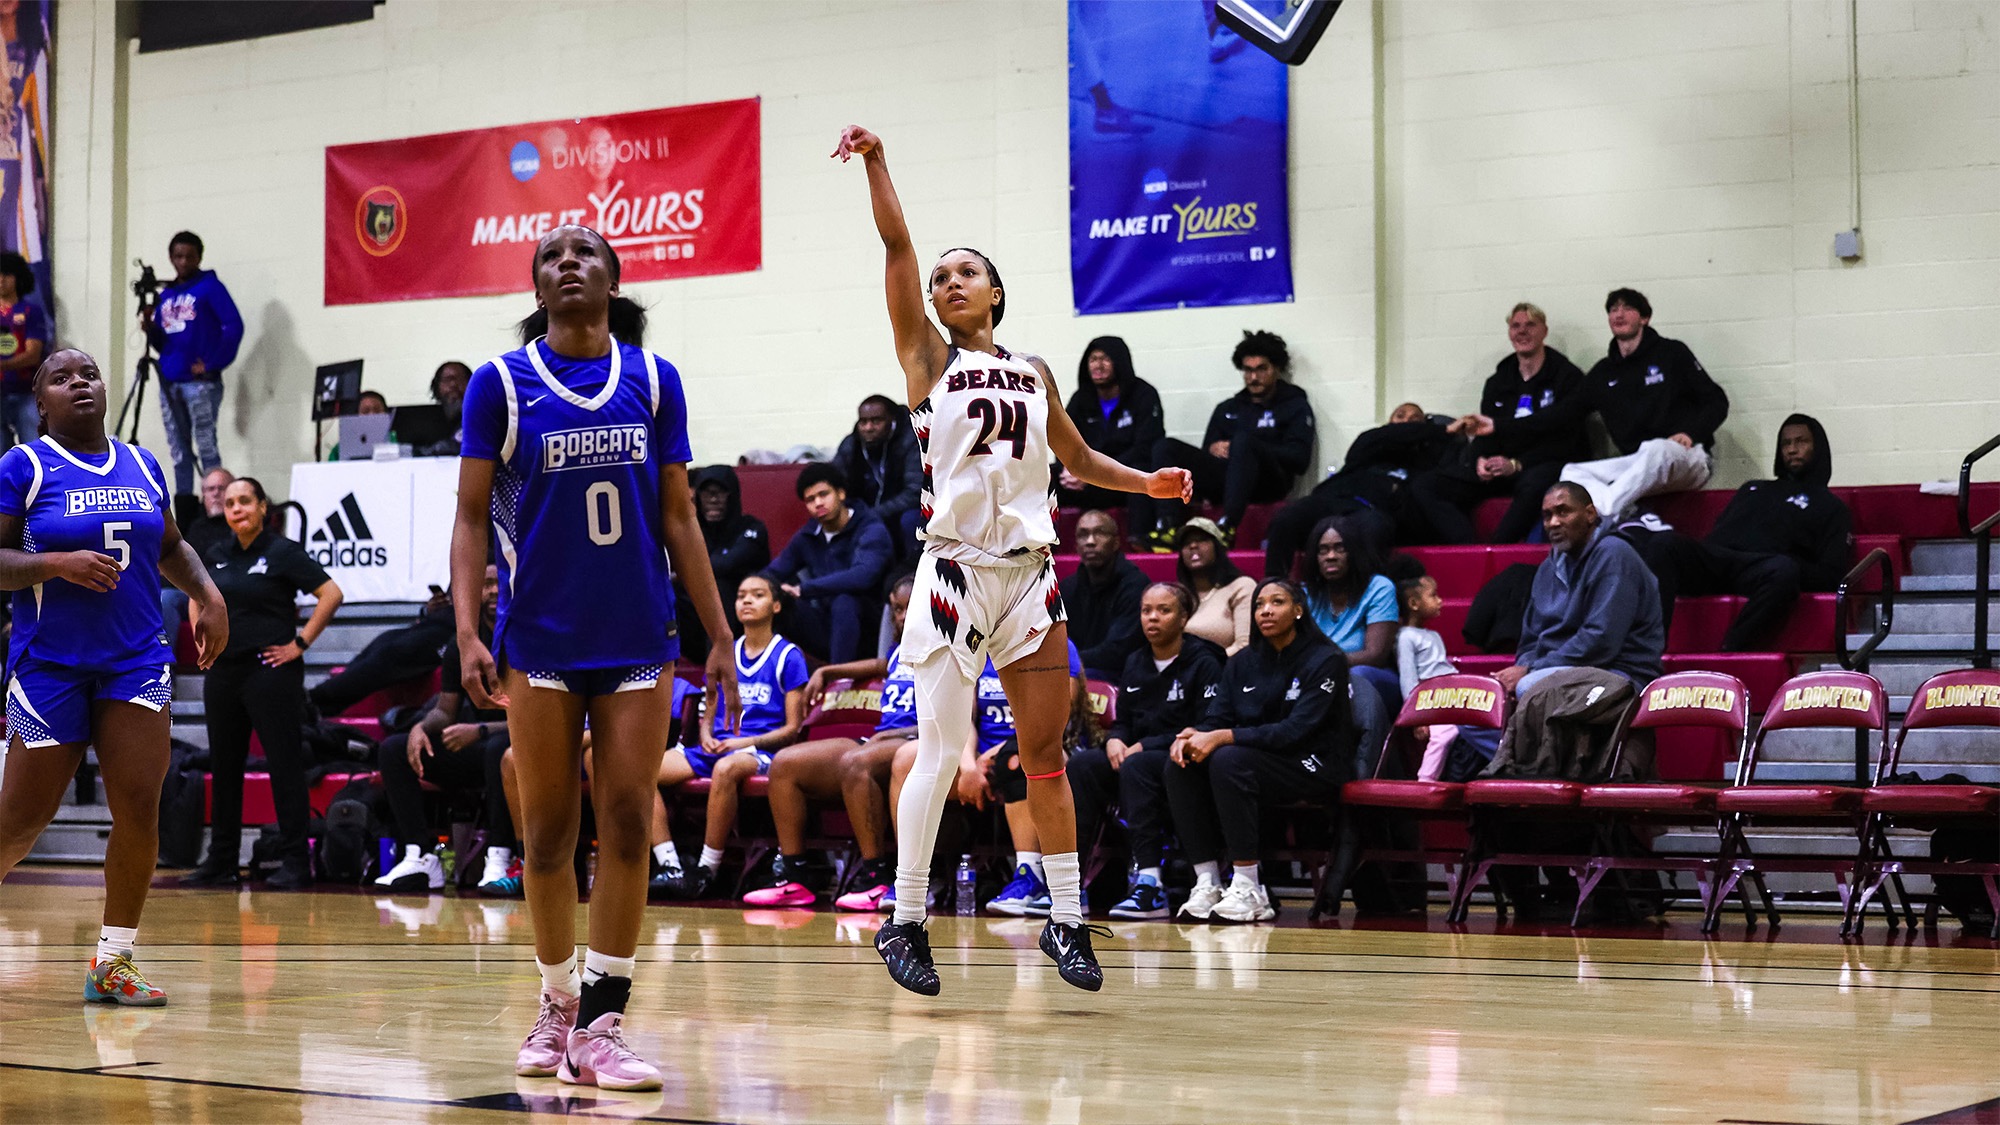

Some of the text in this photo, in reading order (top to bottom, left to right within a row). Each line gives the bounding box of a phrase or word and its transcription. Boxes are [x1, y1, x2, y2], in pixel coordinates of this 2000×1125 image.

[552, 139, 650, 170] DIVISION
[657, 136, 670, 158] II
[471, 212, 553, 246] MAKE
[587, 179, 705, 238] YOURS
[1089, 195, 1258, 243] MAKE IT YOURS
[945, 368, 1036, 395] BEARS
[966, 397, 1028, 461] 24
[547, 427, 646, 468] BOBCATS
[580, 454, 619, 465] ALBANY
[68, 489, 152, 514] BOBCATS
[585, 480, 622, 546] 0
[103, 521, 132, 571] 5
[882, 684, 915, 714] 24
[1320, 678, 1335, 694] 22
[1415, 687, 1496, 712] BLOOMFIELD
[1648, 686, 1735, 712] BLOOMFIELD
[1783, 686, 1873, 712] BLOOMFIELD
[1925, 684, 2000, 710] BLOOMFIE
